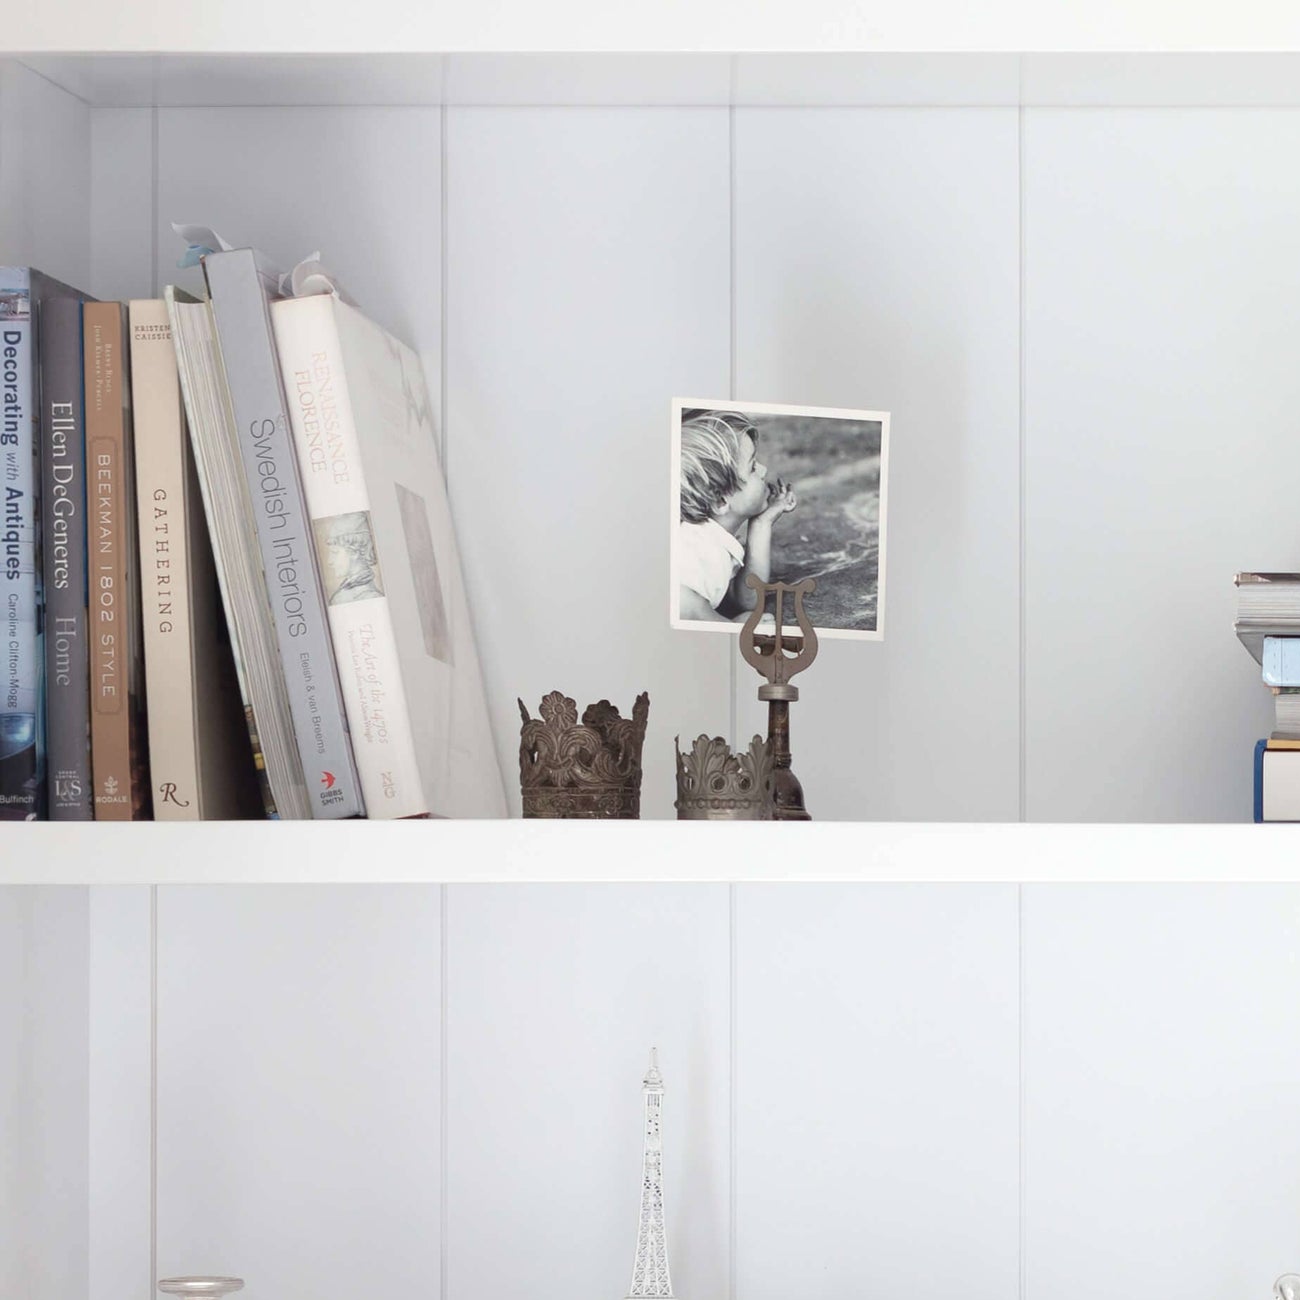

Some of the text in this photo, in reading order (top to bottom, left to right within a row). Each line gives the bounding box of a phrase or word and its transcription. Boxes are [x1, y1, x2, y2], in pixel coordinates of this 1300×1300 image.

[134, 324, 171, 332] KRISTEN
[1, 330, 24, 580] Decorating with Antiques
[295, 370, 328, 473] FLORENCE
[312, 351, 350, 485] RENAISSANCE
[51, 401, 77, 686] Ellen DeGeneres Home
[97, 454, 115, 697] BEEKMAN 1802 STYLE
[153, 488, 172, 633] GATHERING
[250, 418, 308, 638] Swedish Interiors
[7, 593, 19, 708] Caroline Clifton-Mogg
[300, 652, 313, 683] Eleish
[308, 695, 318, 713] van
[368, 674, 382, 686] of
[95, 796, 128, 804] RODALE
[160, 783, 189, 807] R
[320, 788, 342, 799] GIBBS
[321, 796, 344, 806] SMITH
